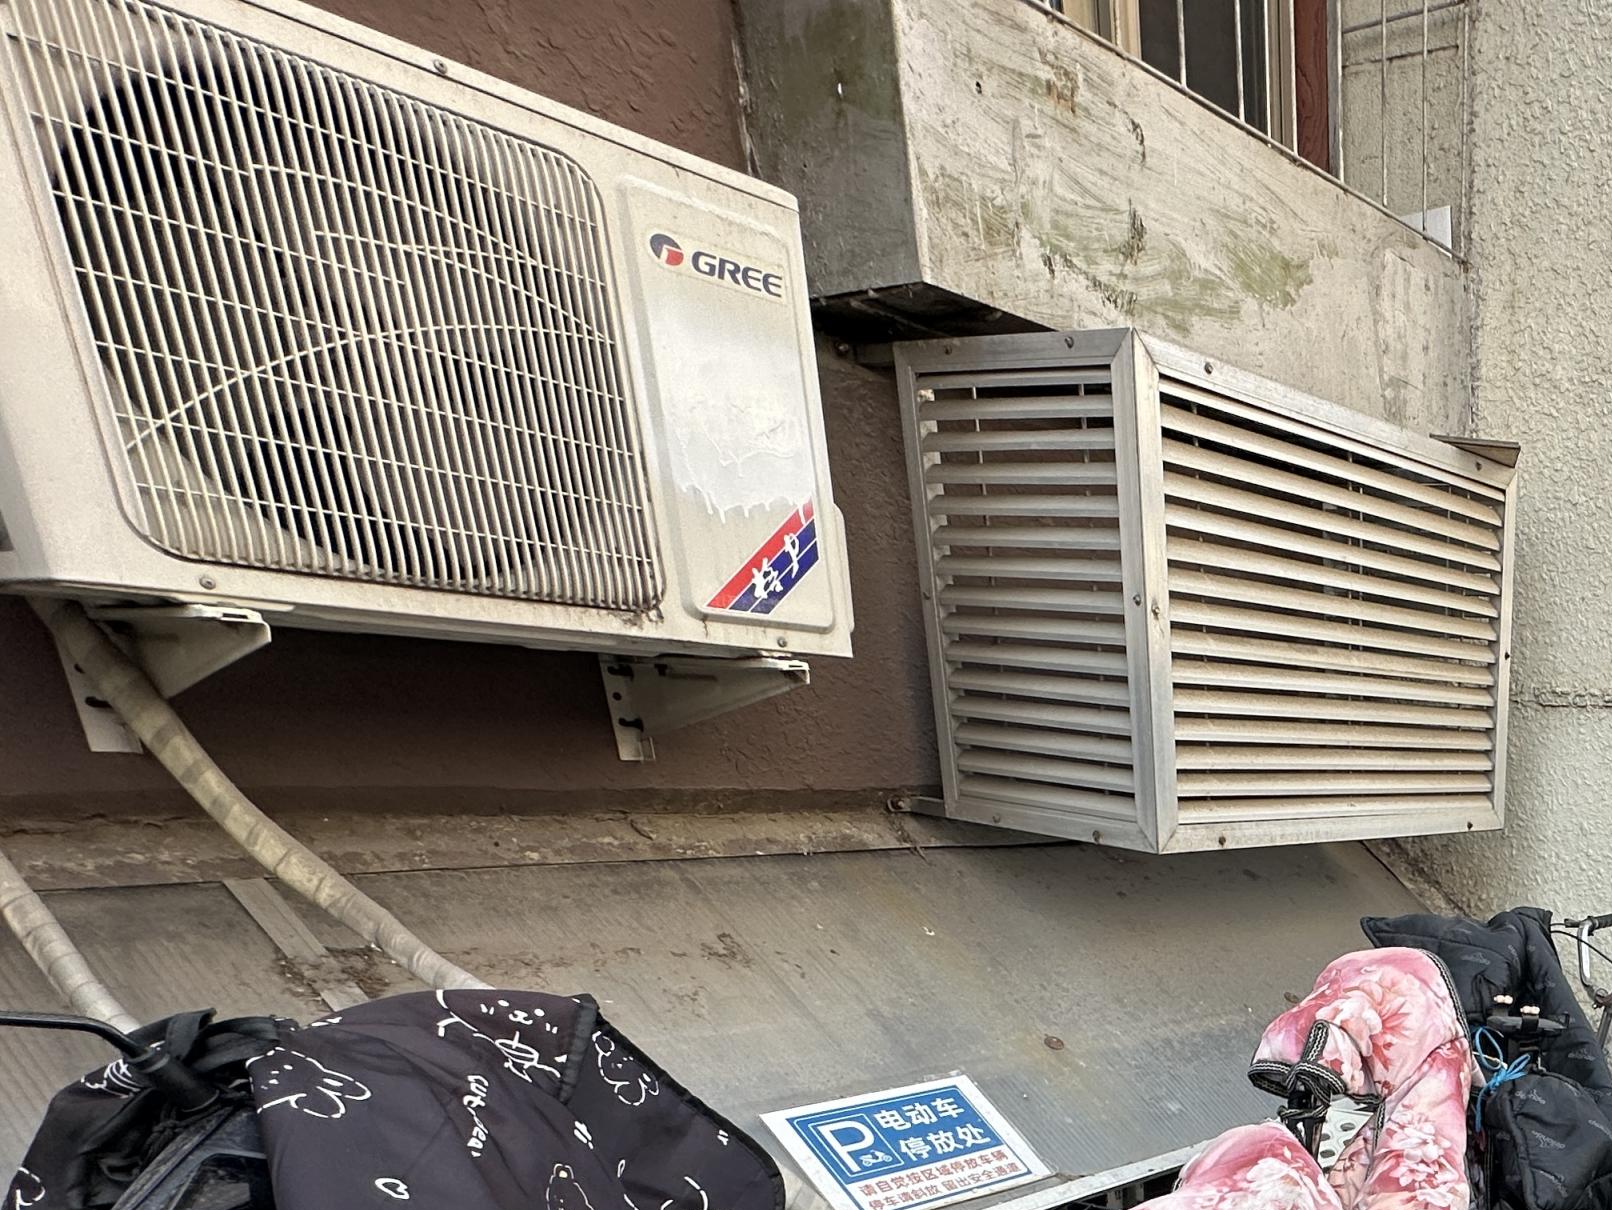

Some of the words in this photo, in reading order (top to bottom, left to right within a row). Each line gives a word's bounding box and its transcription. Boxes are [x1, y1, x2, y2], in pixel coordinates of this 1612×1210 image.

[691, 250, 783, 299] GREE
[873, 1097, 965, 1131] 电动车
[816, 1120, 875, 1173] P
[898, 1123, 992, 1162] 停放处
[858, 1149, 1009, 1198] 请自觉按区域停放车辆
[941, 1161, 1022, 1192] 留出安全通道
